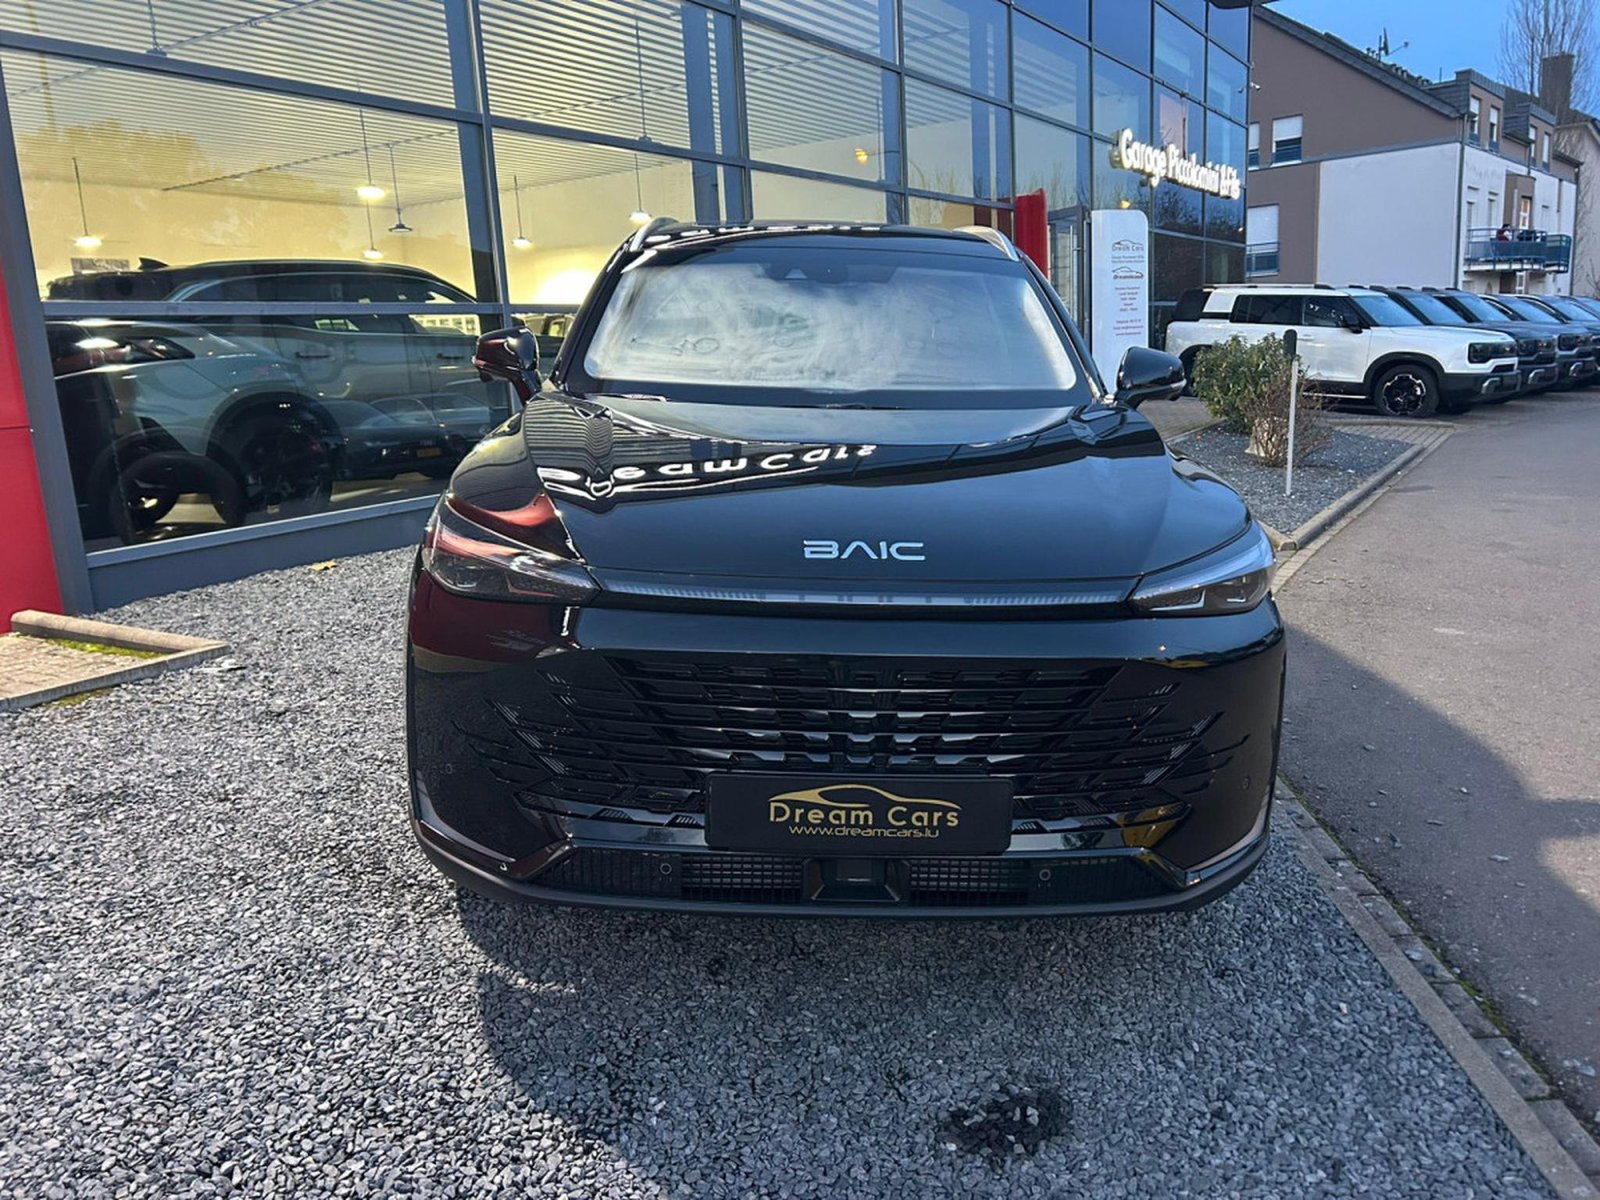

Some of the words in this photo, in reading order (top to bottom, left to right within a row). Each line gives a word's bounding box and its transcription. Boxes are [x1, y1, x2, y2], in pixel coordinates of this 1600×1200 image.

[1120, 128, 1167, 188] Garage
[803, 540, 926, 561] BAIC
[769, 801, 873, 825] Dream
[887, 806, 960, 827] Cars
[788, 825, 940, 838] www.dreamcars.lu
